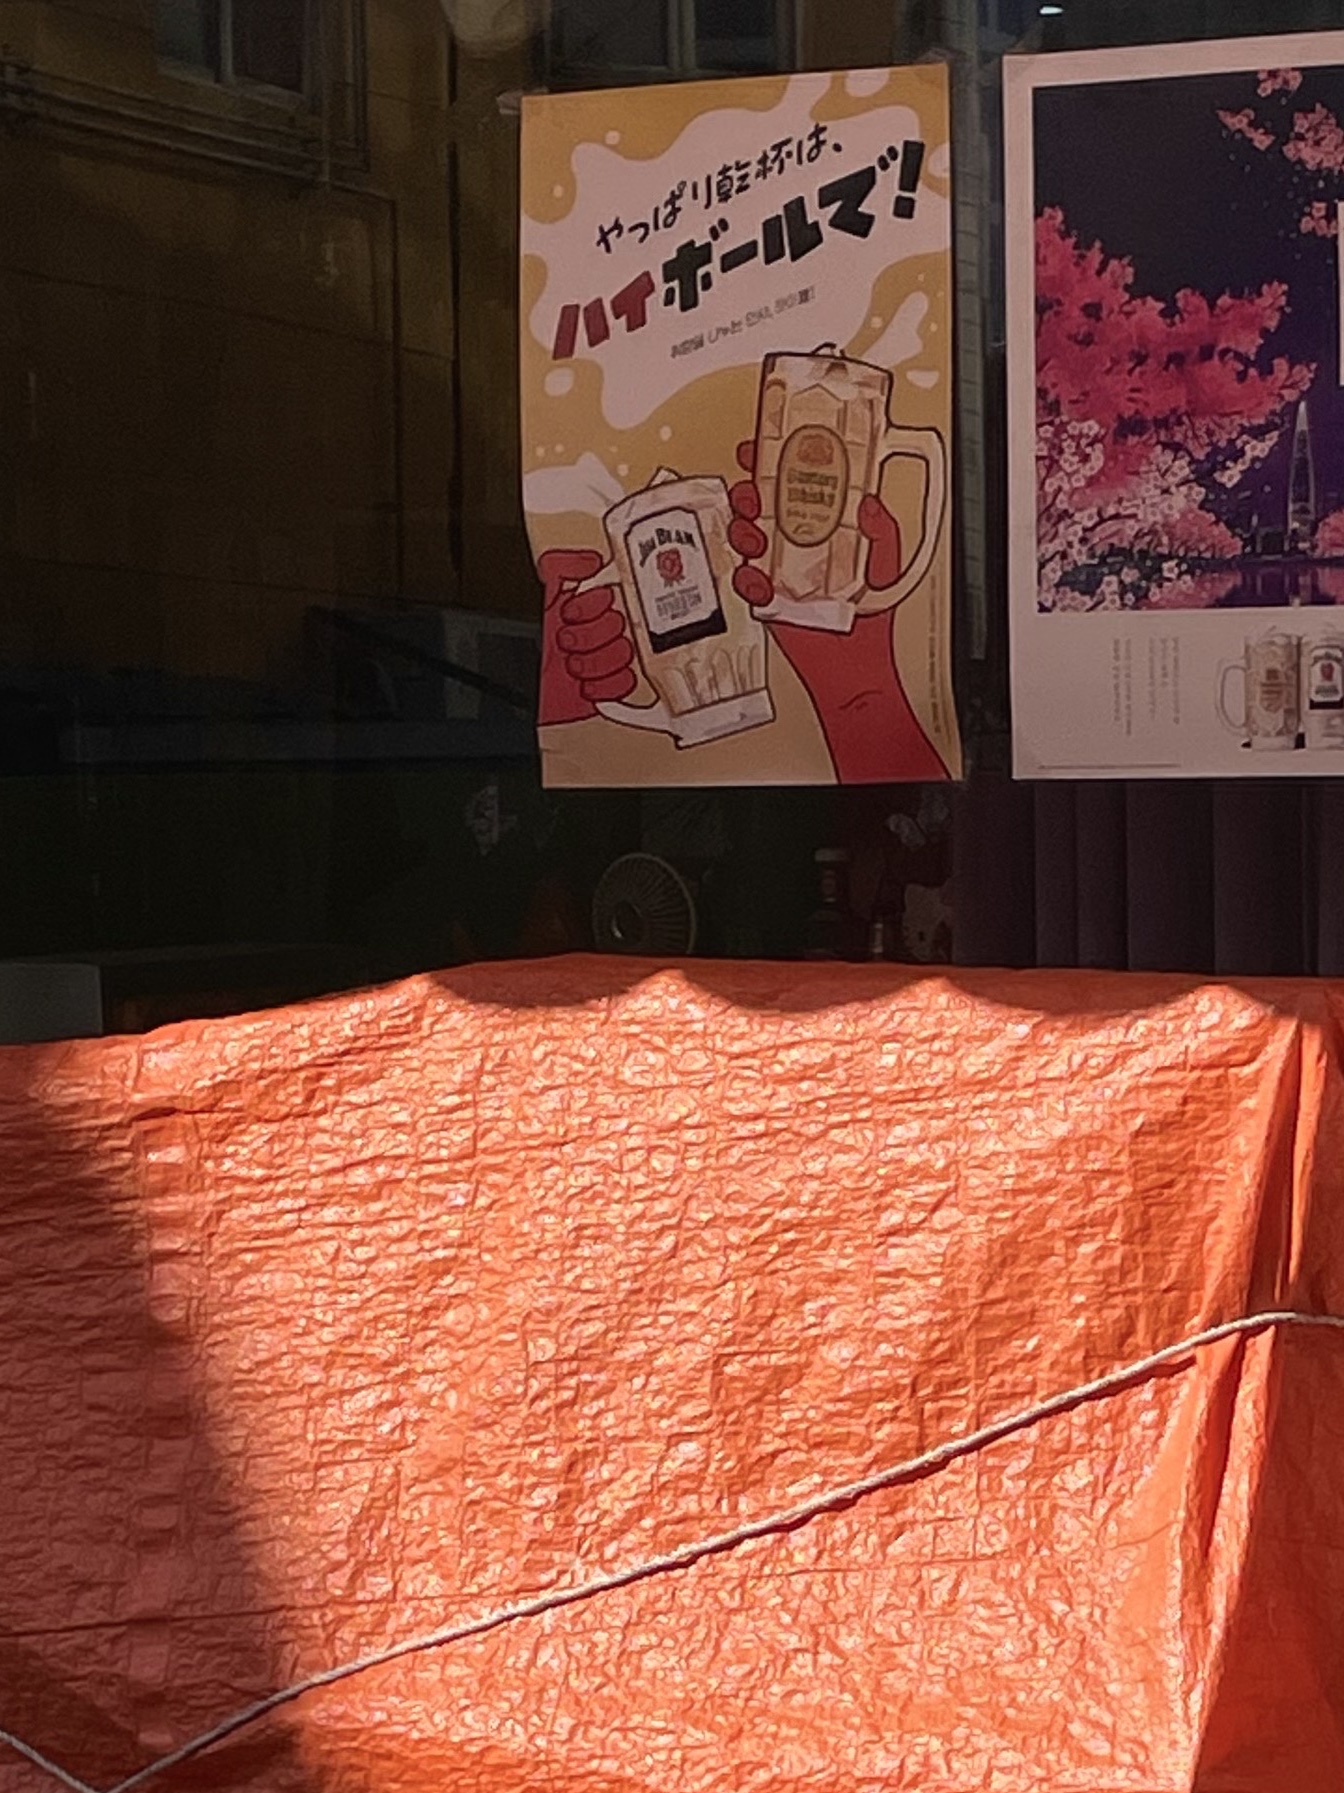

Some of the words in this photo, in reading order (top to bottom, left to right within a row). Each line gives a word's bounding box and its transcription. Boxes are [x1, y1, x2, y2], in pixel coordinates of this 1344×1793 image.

[596, 122, 843, 255] やっぱり乾杯は、
